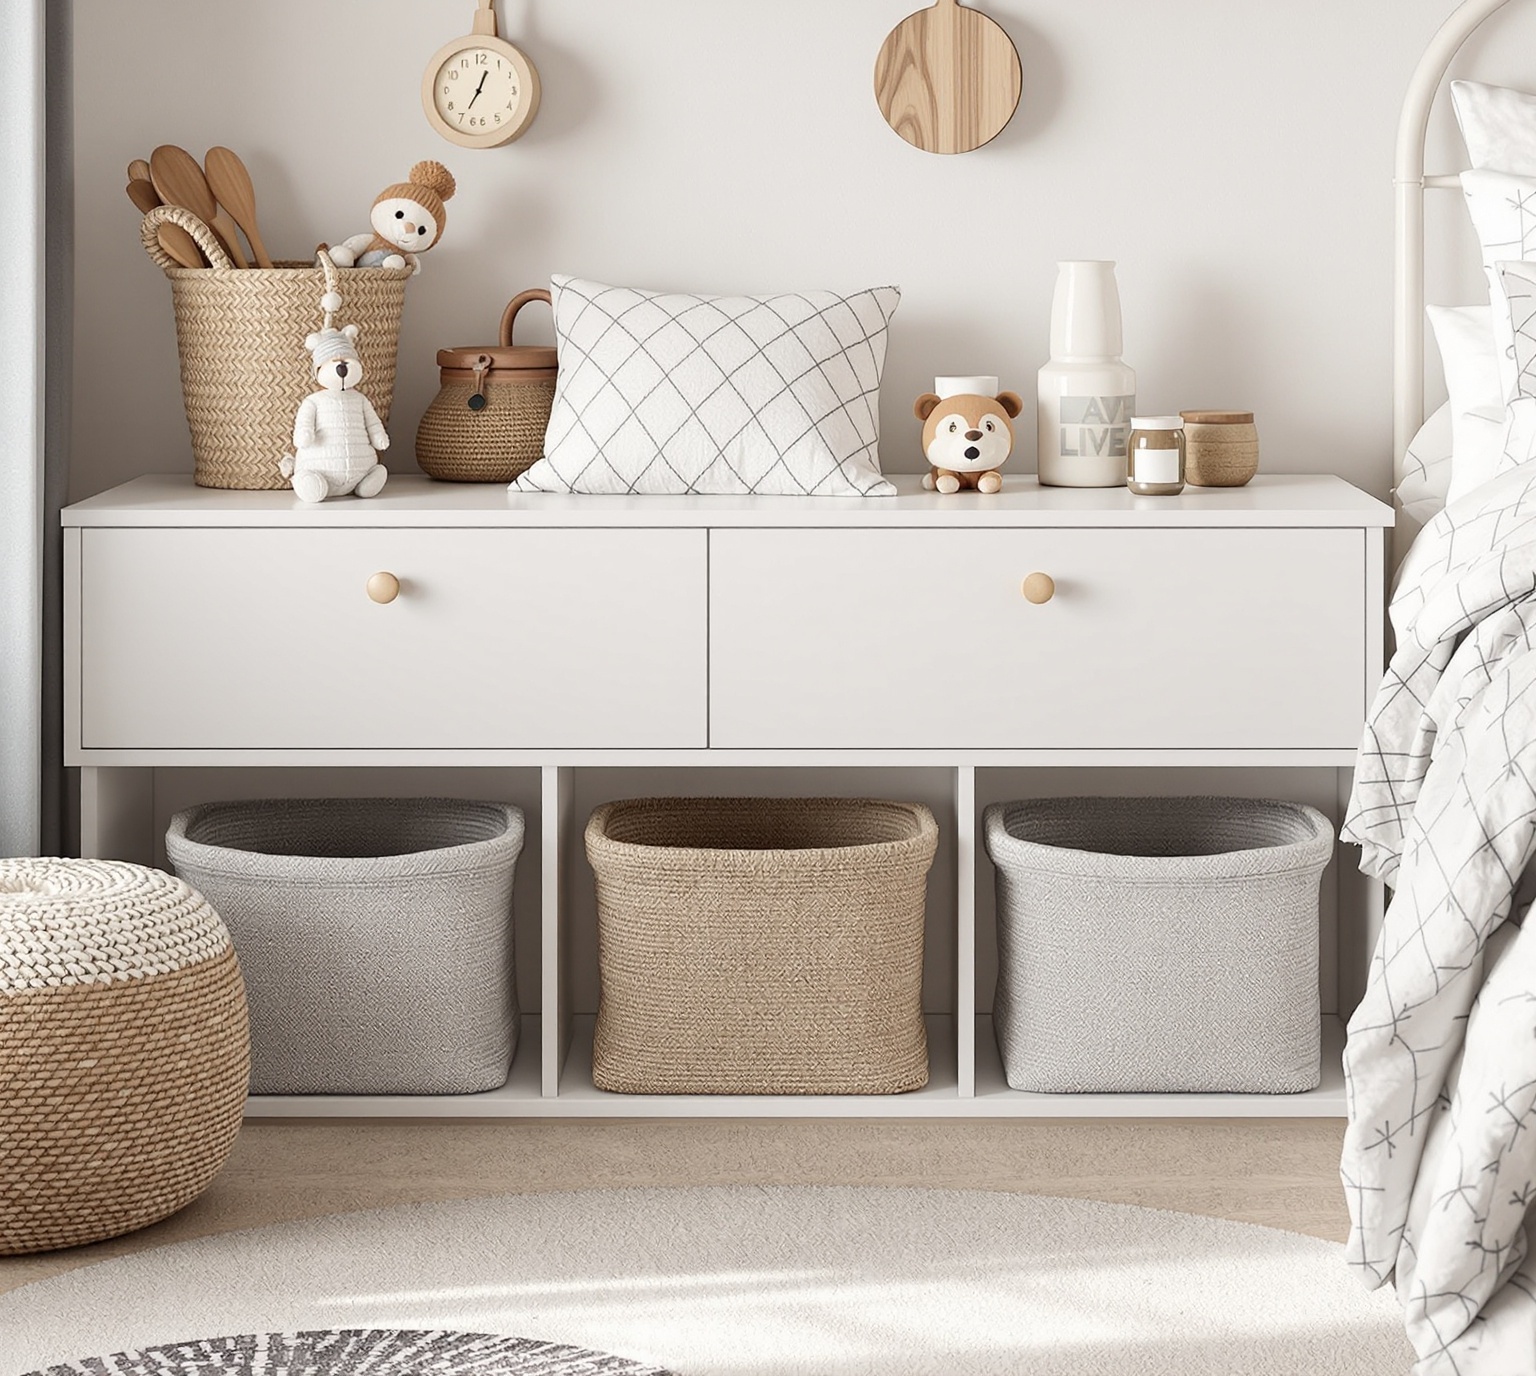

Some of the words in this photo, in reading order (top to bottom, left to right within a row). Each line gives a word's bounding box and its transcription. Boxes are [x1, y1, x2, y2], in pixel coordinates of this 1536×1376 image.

[475, 54, 488, 65] 12
[447, 69, 459, 81] 10
[447, 101, 454, 111] 8
[458, 113, 465, 124] 7
[1060, 428, 1127, 457] LIVE
